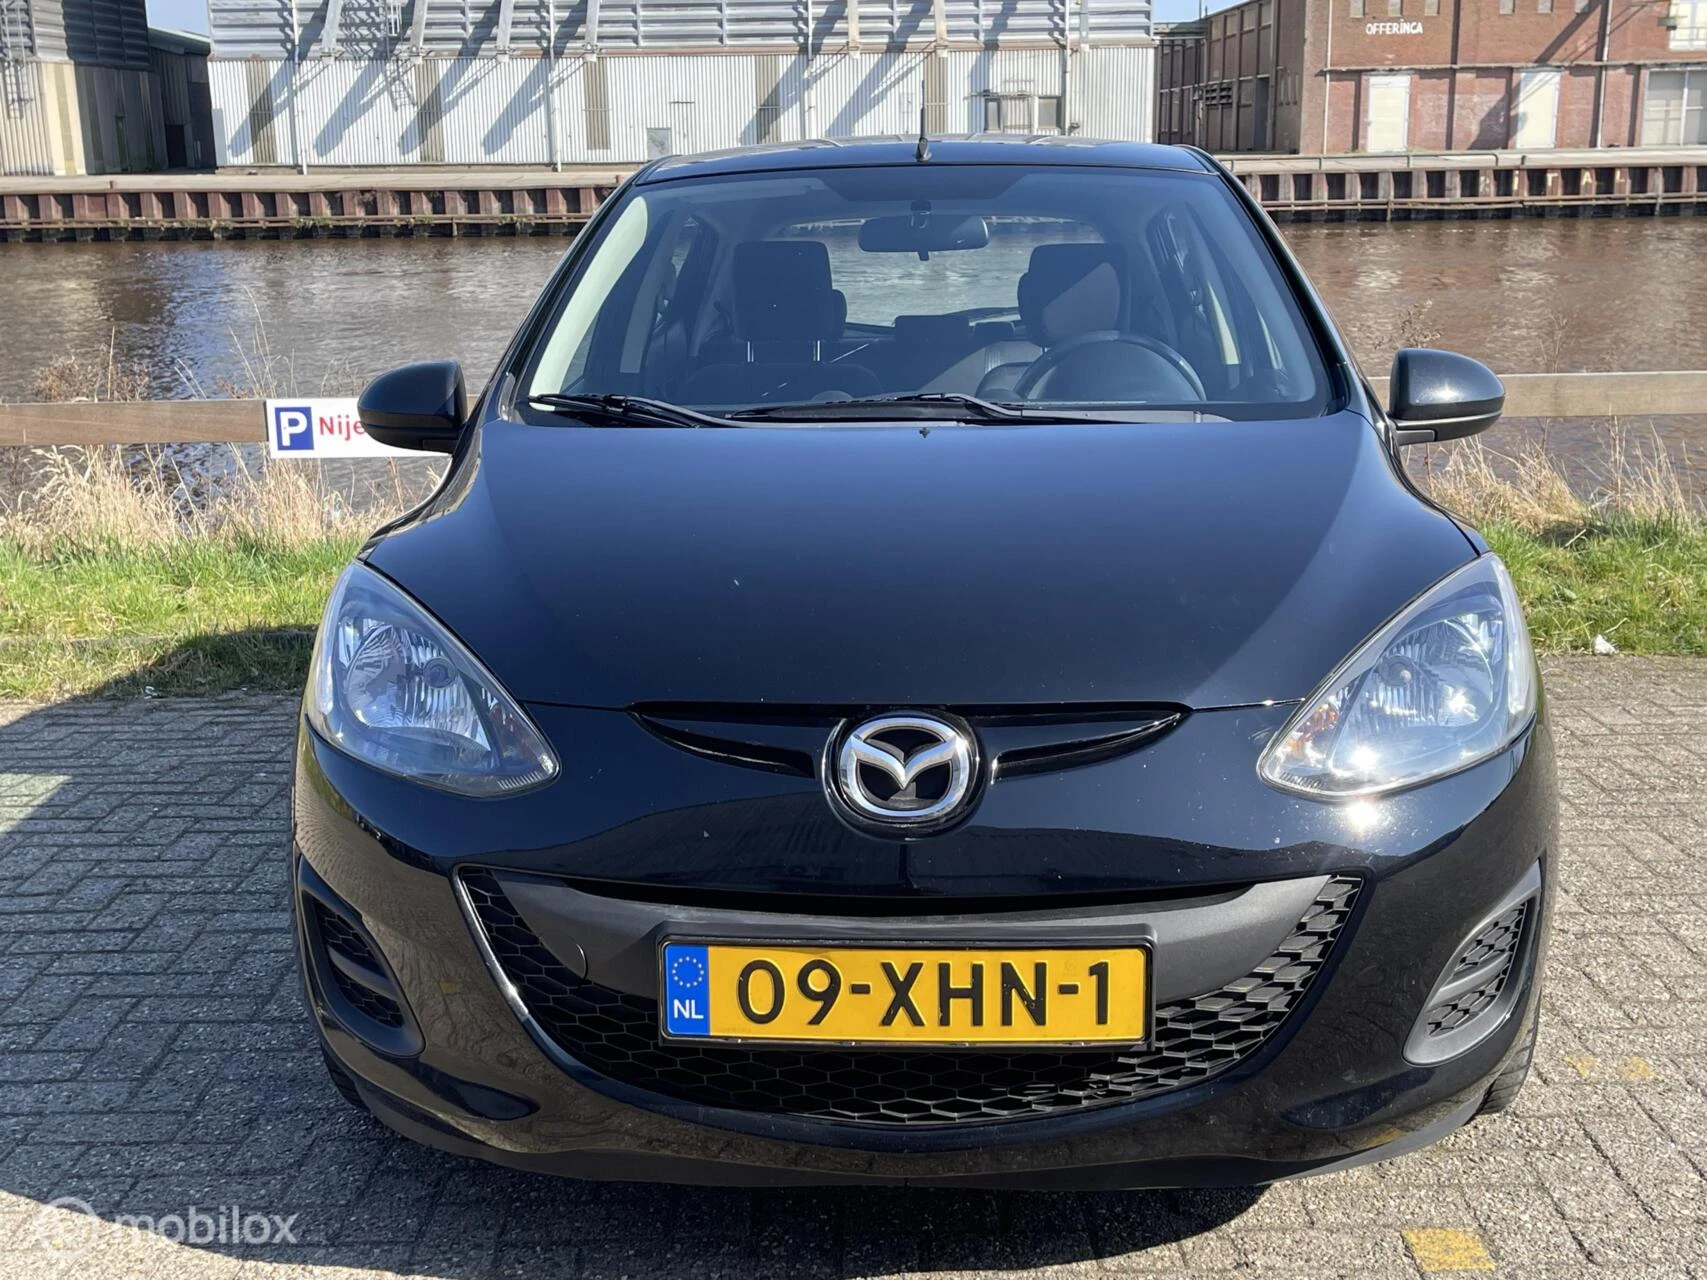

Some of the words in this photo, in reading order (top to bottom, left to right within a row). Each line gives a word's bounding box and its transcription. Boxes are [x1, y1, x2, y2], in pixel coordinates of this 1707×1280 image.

[279, 411, 308, 447] P
[673, 999, 704, 1019] NL
[737, 958, 1109, 1026] 09-XHN-1
